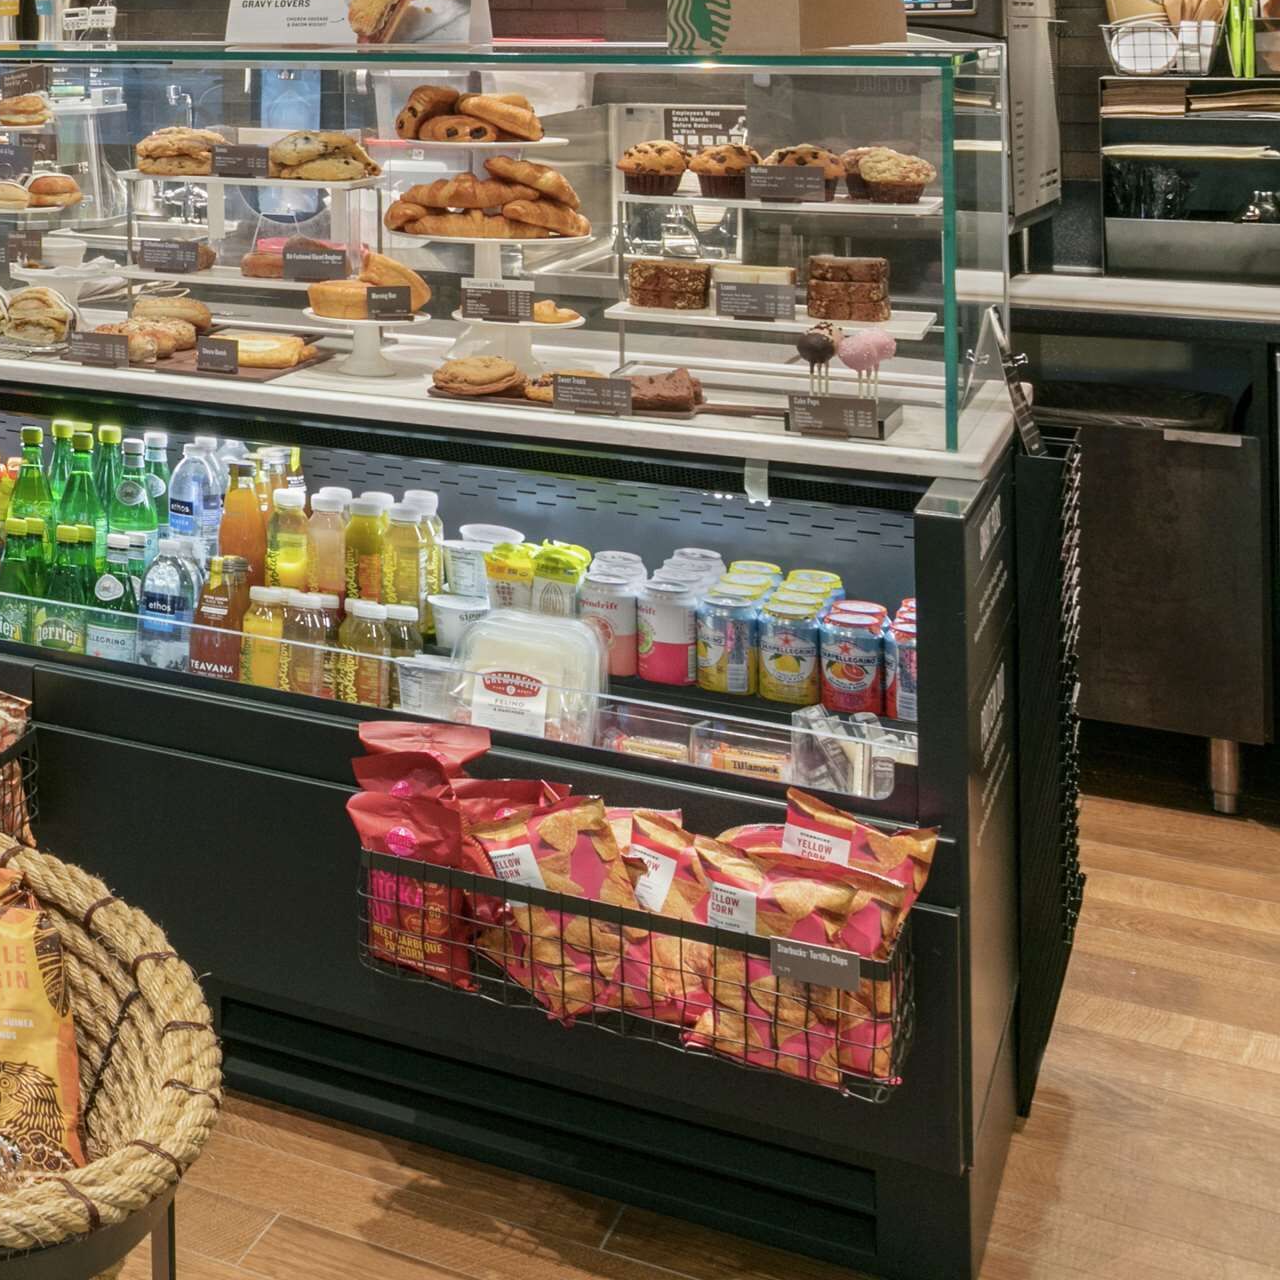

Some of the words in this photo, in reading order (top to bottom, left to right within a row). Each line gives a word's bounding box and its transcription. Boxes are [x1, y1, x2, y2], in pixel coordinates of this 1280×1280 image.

[242, 0, 272, 8] GRAVY
[275, 0, 310, 8] LOVERS
[693, 122, 722, 130] Returning
[170, 502, 191, 514] ethos
[148, 600, 172, 613] ethos
[190, 658, 233, 674] TEAVANA
[732, 760, 779, 773] Tillamook
[797, 837, 832, 856] YELLOW
[496, 857, 521, 870] ELLOW
[711, 902, 734, 916] CORN
[810, 948, 830, 962] Tortilla
[831, 952, 848, 966] Chips
[2, 1018, 34, 1028] GUINEA
